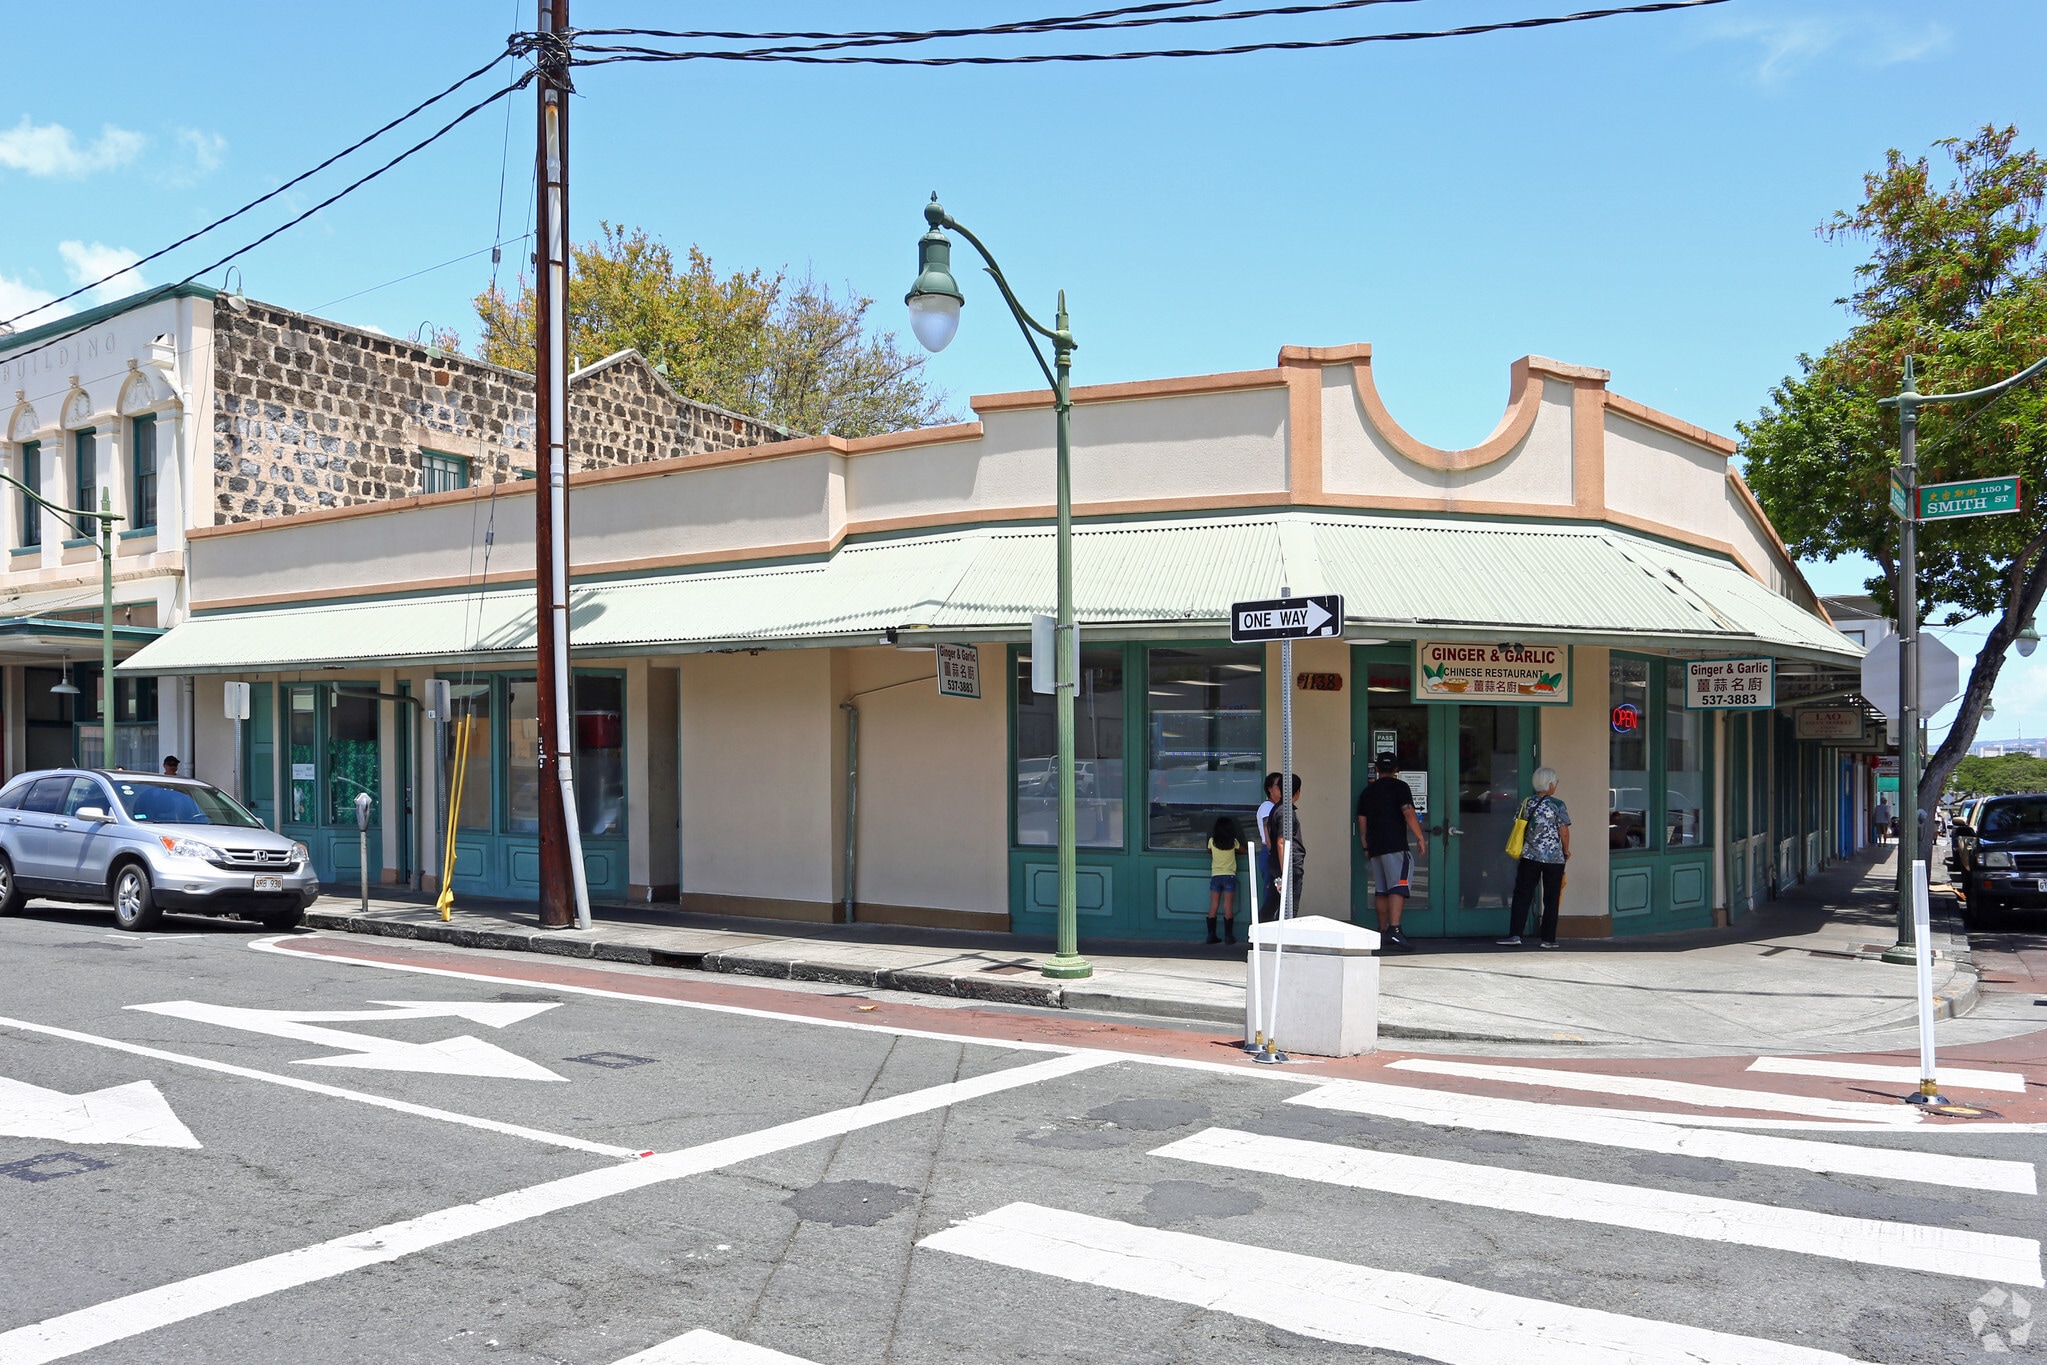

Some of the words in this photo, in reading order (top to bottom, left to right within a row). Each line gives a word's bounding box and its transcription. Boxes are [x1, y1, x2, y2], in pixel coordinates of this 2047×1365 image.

[3, 333, 115, 383] BUILDING
[1980, 485, 2002, 494] 1150
[1927, 497, 1987, 514] SMITH
[1994, 495, 2009, 503] ST
[1244, 612, 1271, 629] ONE
[1279, 610, 1308, 626] WAY
[940, 645, 956, 660] Ginger
[957, 648, 961, 659] &
[961, 649, 976, 662] Garlic
[1431, 647, 1486, 662] GINGER
[1490, 649, 1500, 662] &
[1504, 650, 1556, 664] GARLIC
[1443, 667, 1483, 677] CHINESE
[1485, 668, 1544, 679] RESTAURANT
[1690, 663, 1724, 677] Ginger
[1726, 663, 1734, 674] &
[1737, 661, 1769, 674] Garlic
[947, 679, 974, 693] 537-3883
[1701, 694, 1757, 706] 537-3883
[1612, 708, 1638, 728] OPEN
[1815, 713, 1842, 721] LAO
